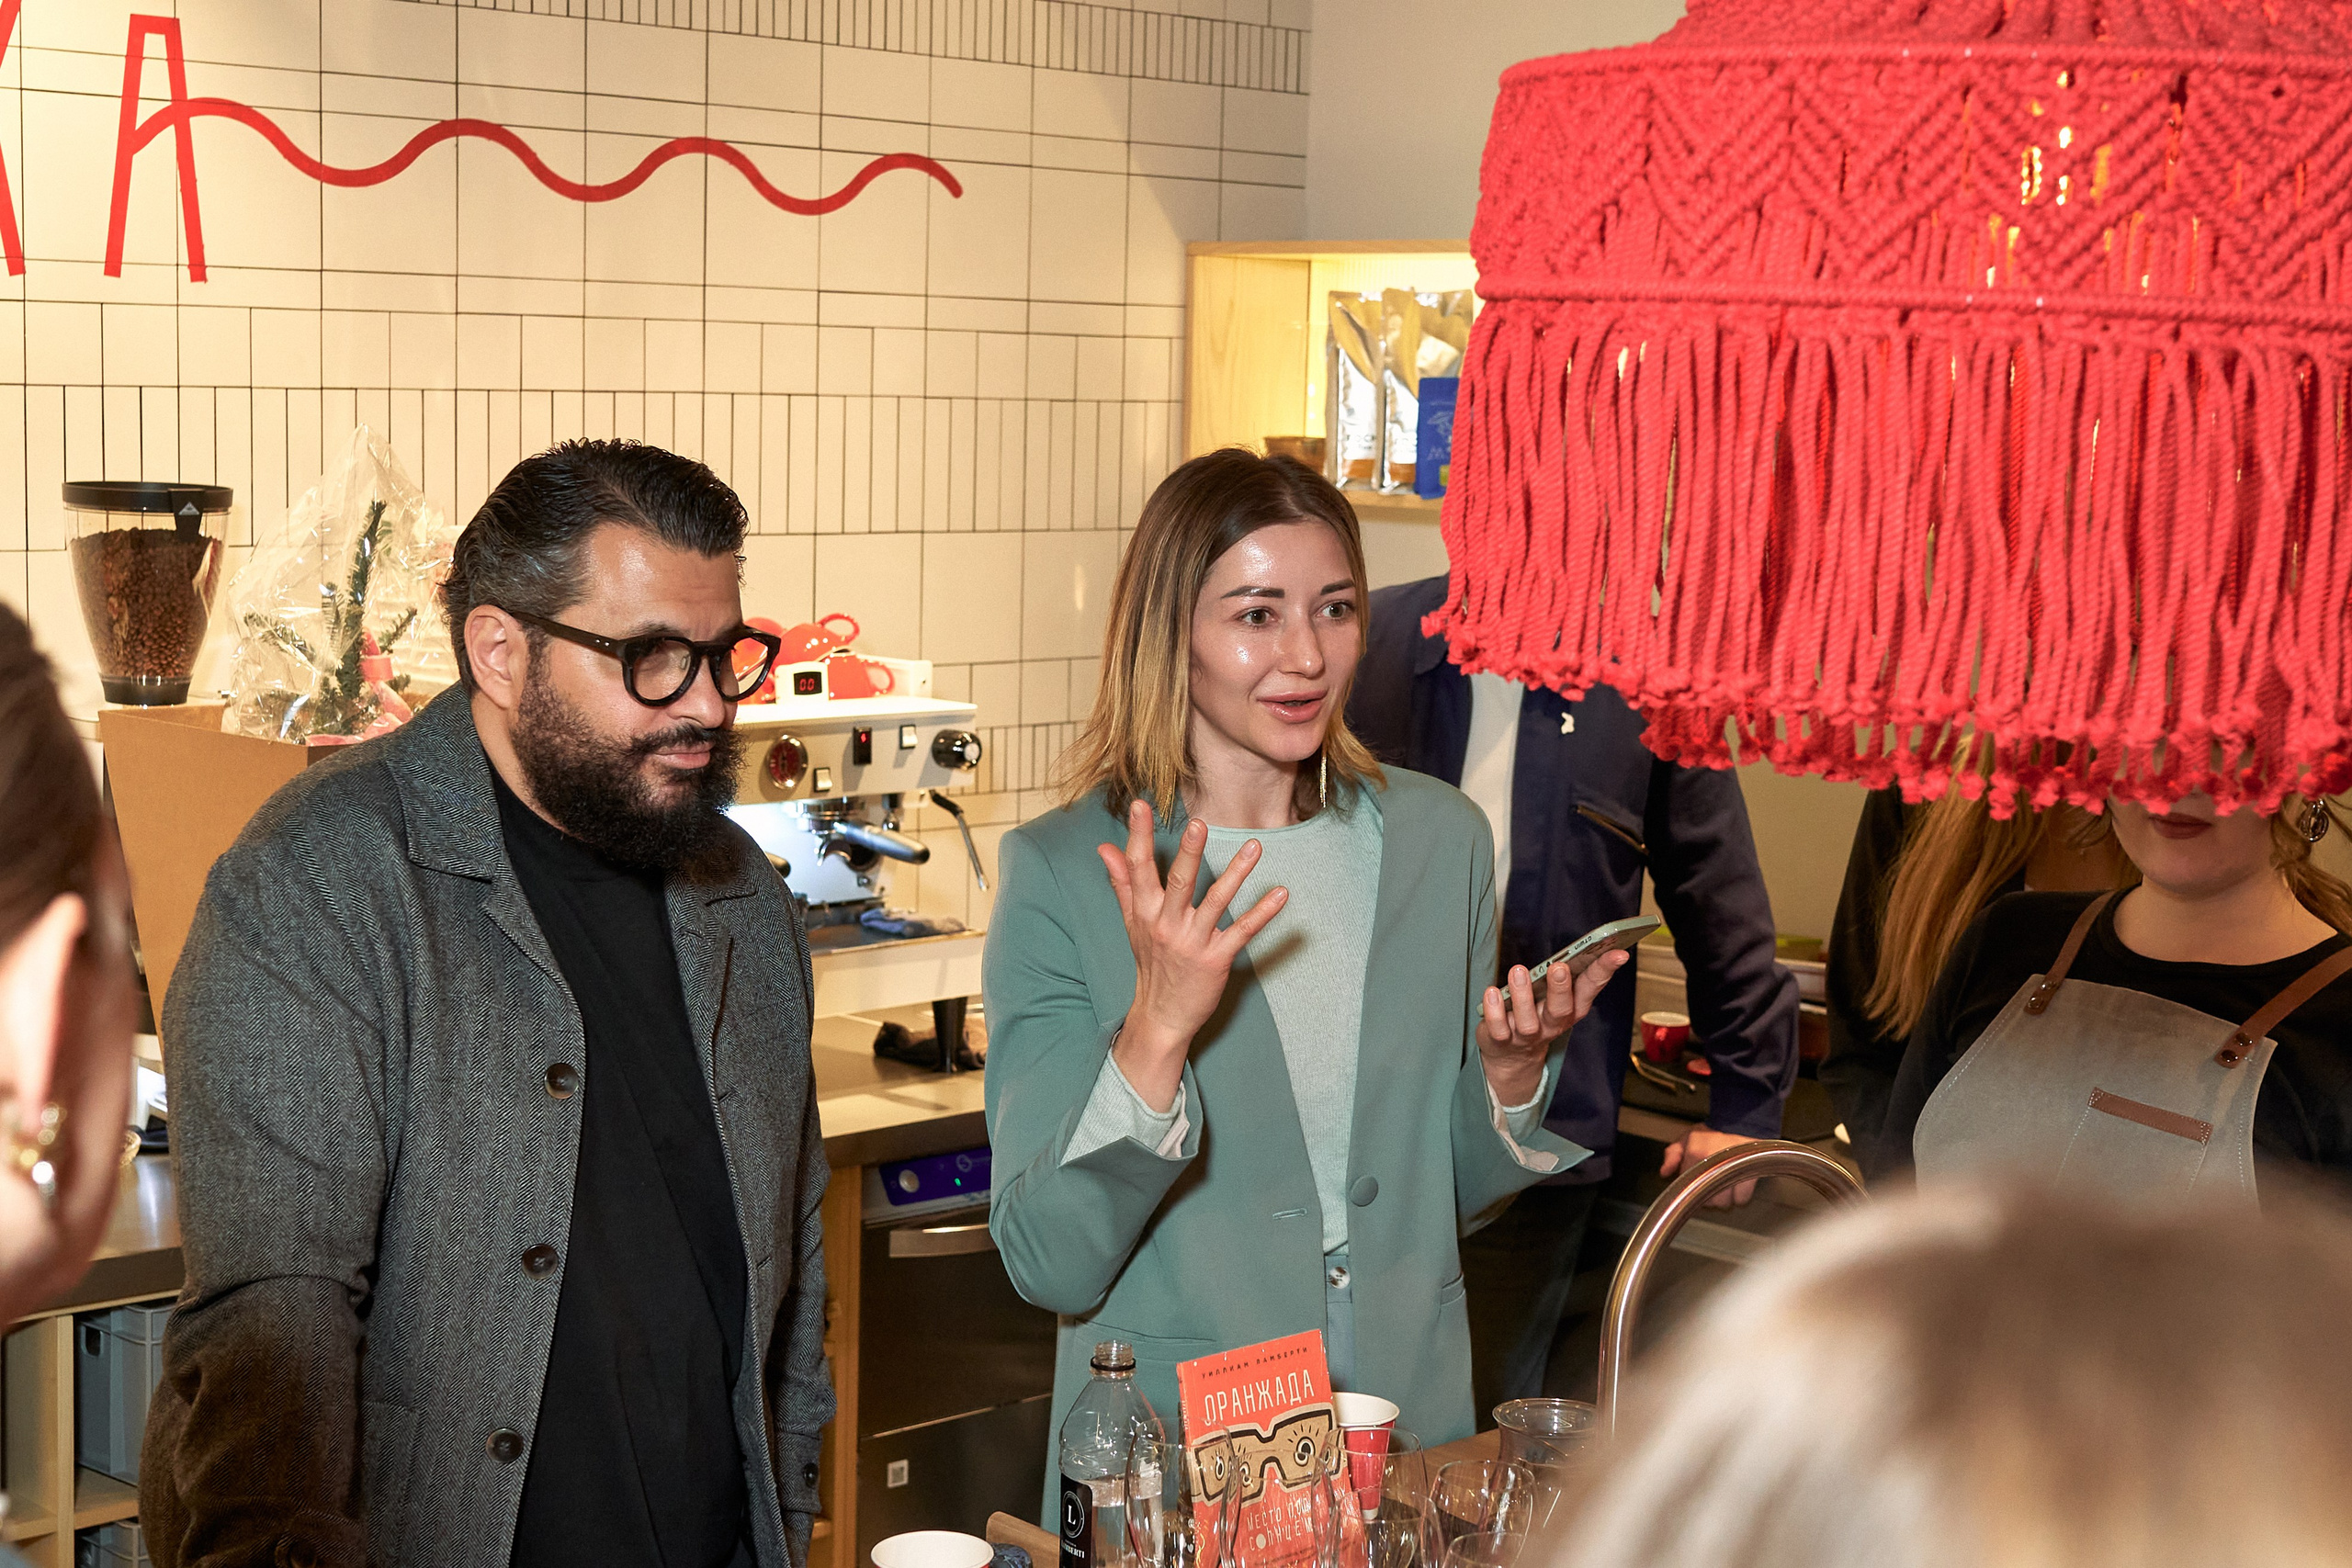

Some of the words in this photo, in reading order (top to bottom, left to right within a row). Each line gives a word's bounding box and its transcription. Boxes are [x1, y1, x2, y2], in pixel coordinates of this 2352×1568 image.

[1202, 1361, 1249, 1379] УИЛЛИАМ
[1256, 1347, 1307, 1365] ЛАМБЕРТИ
[1204, 1369, 1315, 1426] ОРАНЖАДА
[1068, 1505, 1077, 1525] L
[1246, 1506, 1283, 1531] МЕСТО
